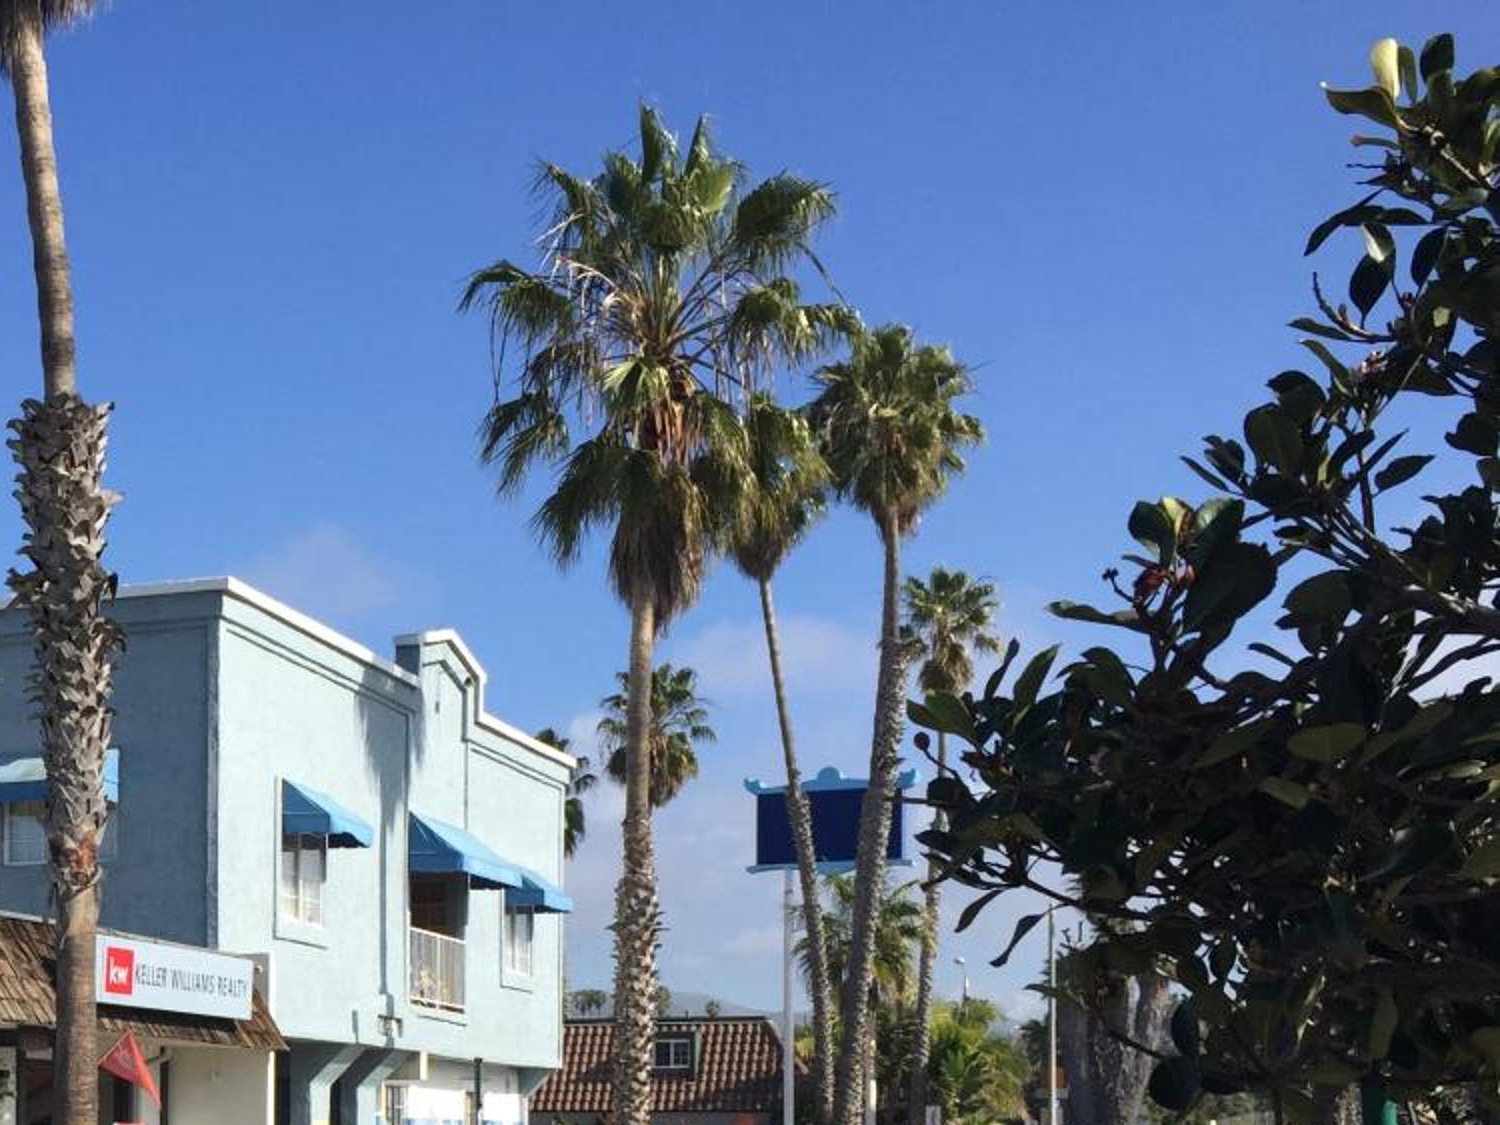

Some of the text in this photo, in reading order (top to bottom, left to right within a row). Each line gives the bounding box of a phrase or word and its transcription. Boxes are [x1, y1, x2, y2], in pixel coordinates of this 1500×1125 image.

[109, 956, 247, 999] kw KELLER WILLIAMS REALTY
